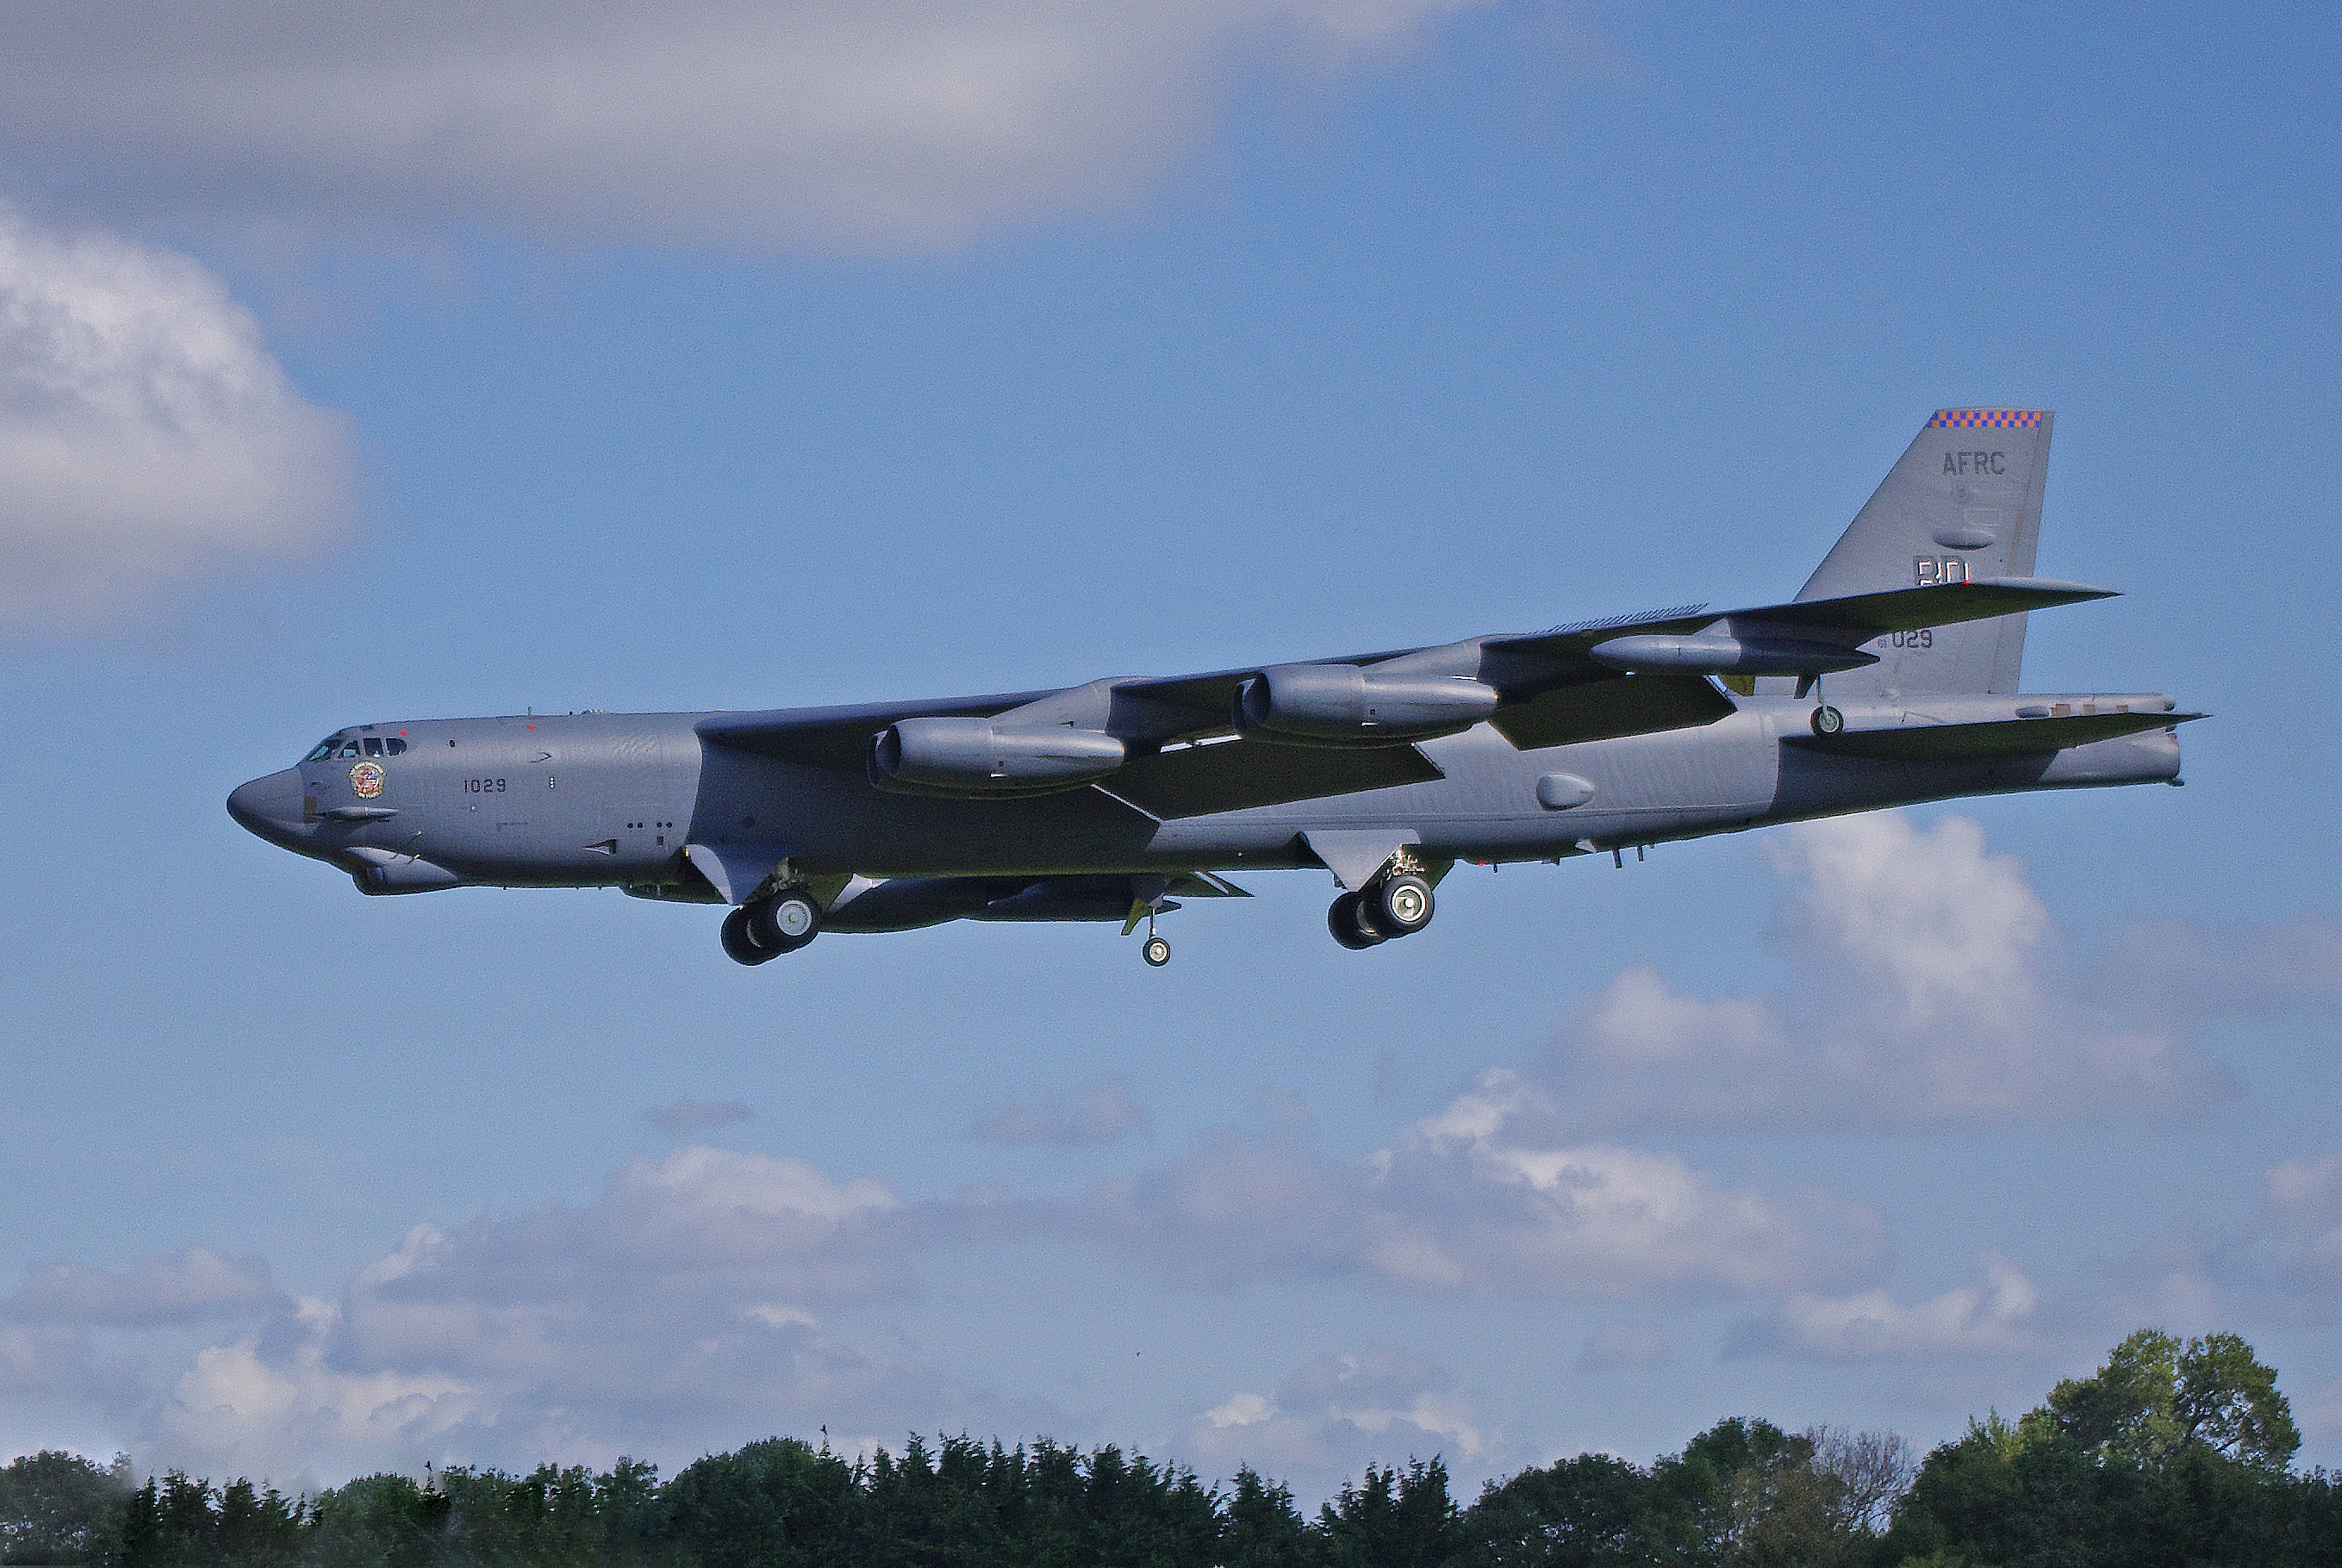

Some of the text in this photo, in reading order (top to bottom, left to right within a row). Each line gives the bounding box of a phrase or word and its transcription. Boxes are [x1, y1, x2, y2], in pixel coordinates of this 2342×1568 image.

[1942, 451, 2005, 476] AFRC
[1891, 629, 1933, 648] 029
[464, 778, 507, 793] 1029
